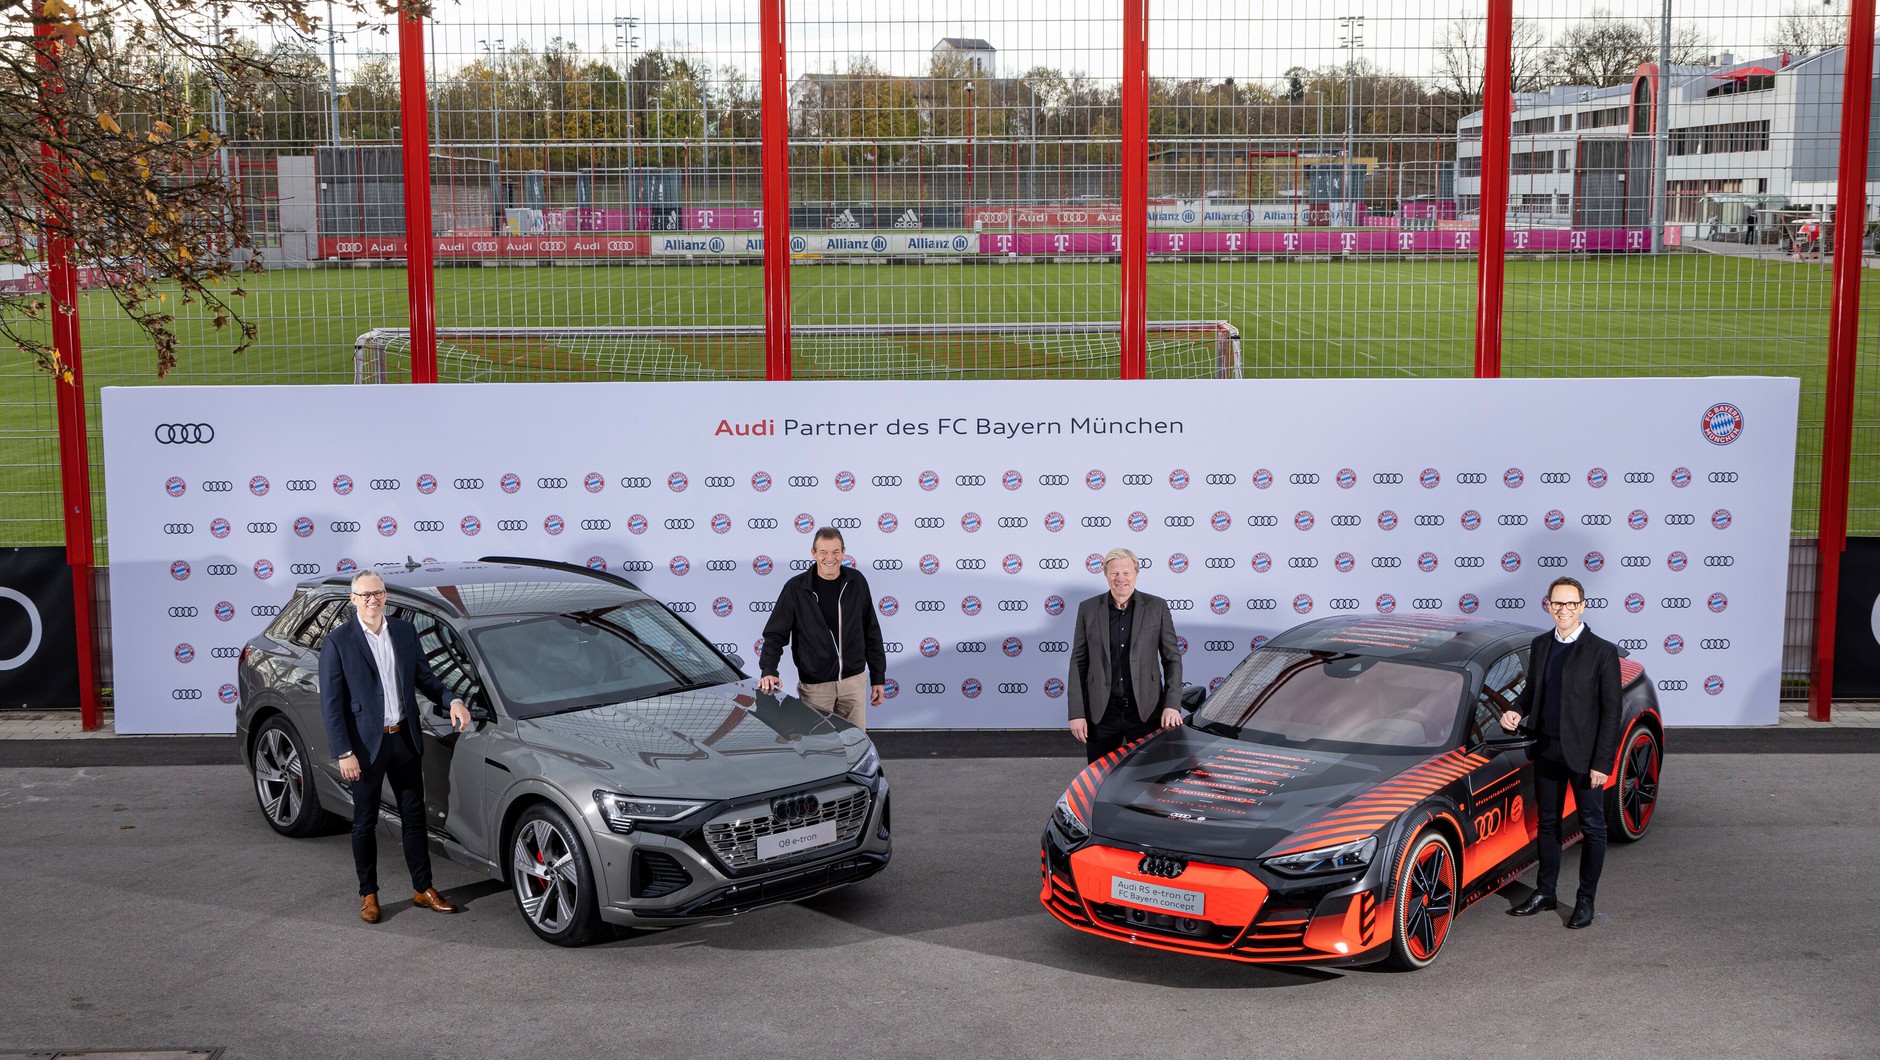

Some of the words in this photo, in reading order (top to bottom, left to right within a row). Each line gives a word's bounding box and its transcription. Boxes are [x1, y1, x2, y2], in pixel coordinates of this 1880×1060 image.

[1018, 213, 1048, 222] Audi
[894, 220, 922, 229] adidas
[370, 243, 397, 252] Audi
[439, 243, 465, 251] Audi
[506, 242, 533, 251] Audi
[574, 242, 600, 251] Audi
[664, 239, 706, 251] Allianz
[826, 238, 869, 250] Allianz
[908, 237, 950, 249] Allianz
[1705, 411, 1714, 422] FC
[1713, 406, 1741, 421] BAYERN
[714, 419, 775, 437] Audi
[784, 419, 879, 436] Partner
[886, 418, 930, 436] des
[938, 417, 968, 436] FC
[976, 417, 1062, 440] Bayern
[1070, 416, 1184, 435] München
[778, 839, 791, 848] Q8
[792, 833, 817, 845] e-tron
[1117, 880, 1137, 892] Audi
[1139, 885, 1150, 894] RS
[1152, 889, 1181, 900] e-tron
[1183, 893, 1197, 902] GT
[1118, 889, 1128, 898] FC
[1130, 892, 1158, 905] Bayern
[1160, 898, 1195, 911] concept
